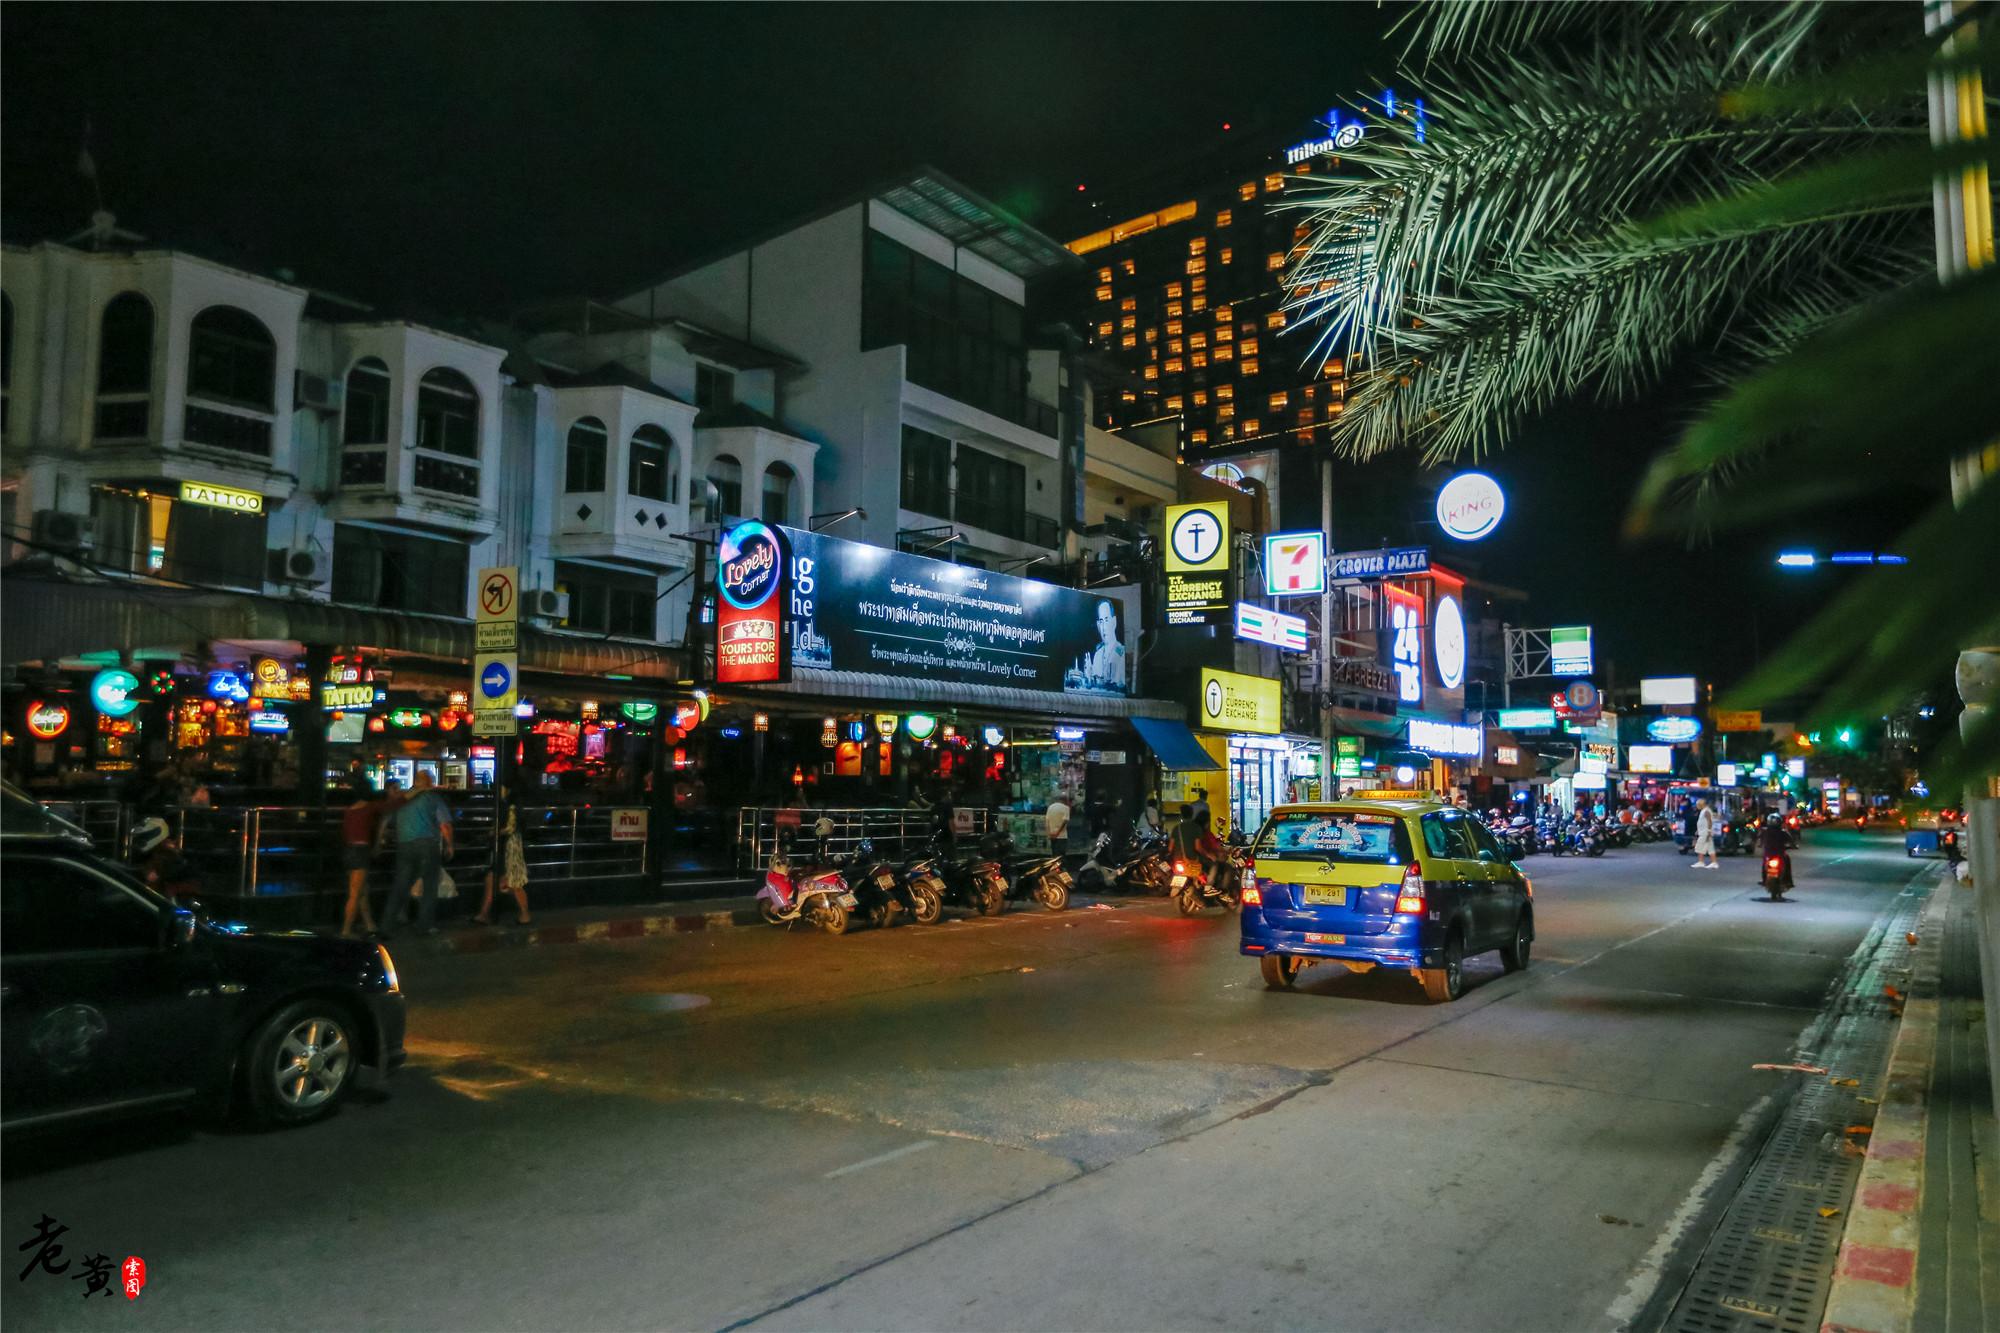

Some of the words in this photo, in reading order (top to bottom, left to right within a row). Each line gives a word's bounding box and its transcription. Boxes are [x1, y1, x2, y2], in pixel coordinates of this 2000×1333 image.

[1287, 138, 1334, 164] Hilton
[185, 486, 260, 510] TATTOO
[1448, 496, 1492, 523] KING
[725, 543, 774, 589] Lovely
[1387, 553, 1427, 571] PLAZA
[740, 569, 771, 596] Corner
[1168, 581, 1223, 593] CURRENCY
[1169, 576, 1184, 585] T.T.
[1168, 590, 1223, 601] EXCHANGE
[1168, 616, 1205, 624] EXCHANGE
[721, 643, 753, 655] YOURS
[755, 641, 775, 653] FOR
[721, 655, 736, 666] THE
[738, 653, 775, 666] MAKING
[343, 670, 358, 681] LEO
[987, 660, 1012, 679] Lovely
[324, 686, 374, 706] TATTOO
[1226, 697, 1257, 710] CURRENCY
[1226, 707, 1257, 721] EXCHANGE
